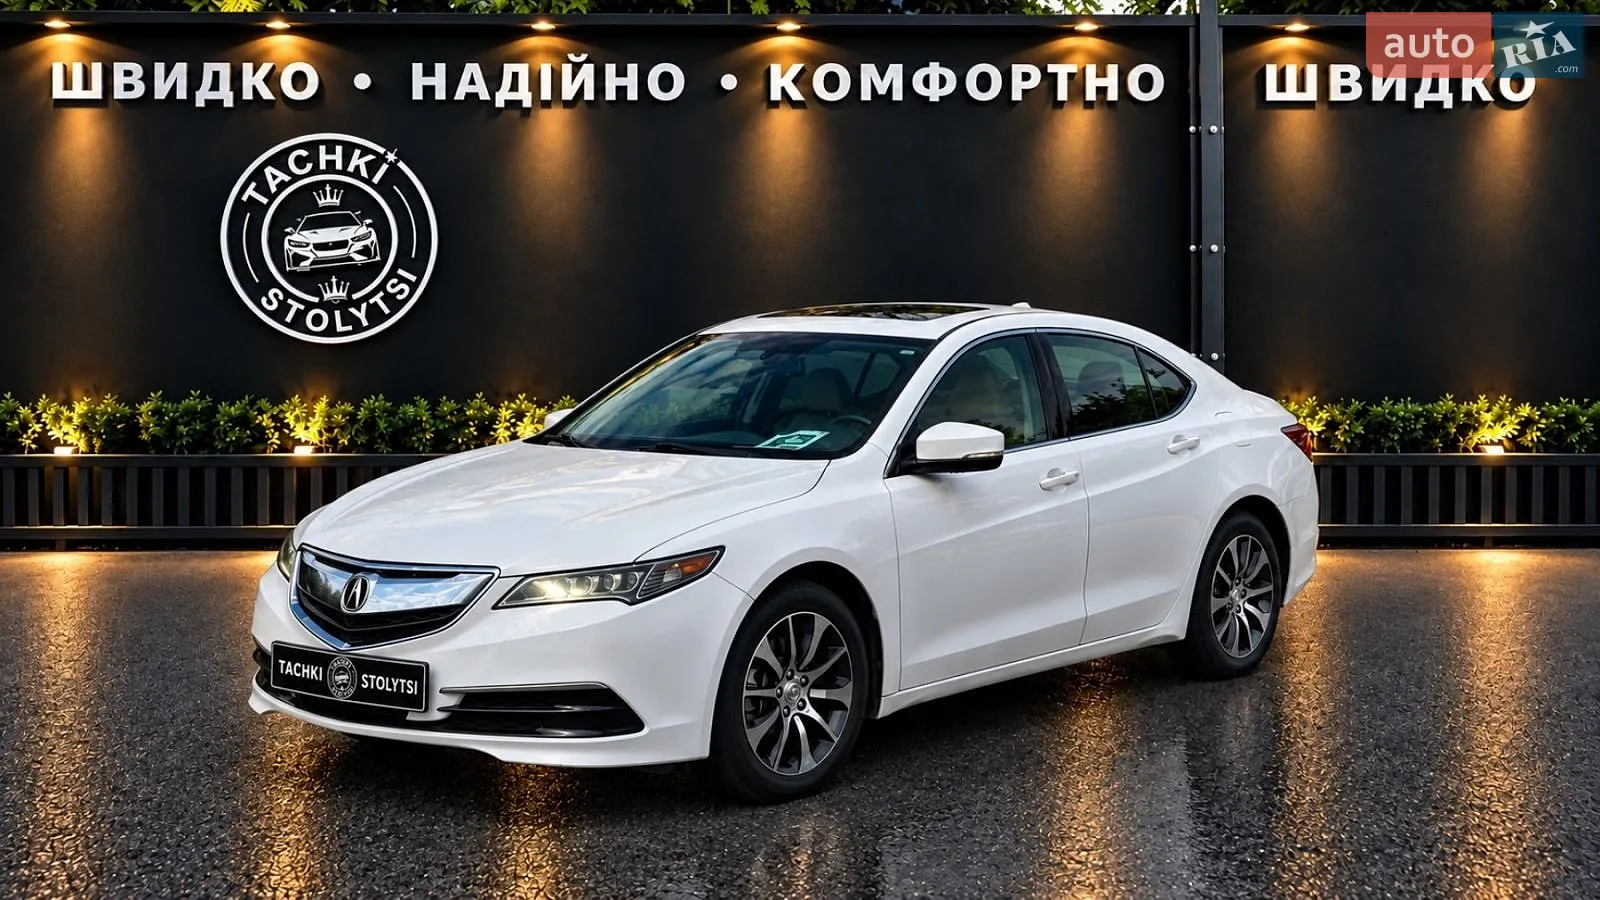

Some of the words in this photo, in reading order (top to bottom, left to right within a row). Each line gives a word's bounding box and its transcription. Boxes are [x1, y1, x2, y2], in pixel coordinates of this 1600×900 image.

[51, 61, 319, 108] ШВИДКО
[411, 52, 686, 108] НАДІЙНО
[769, 61, 1165, 102] КОМФОРТНО
[1265, 63, 1536, 109] ШВИДКО
[241, 144, 390, 205] TACHKI
[260, 267, 418, 333] STOLYTSI
[278, 659, 323, 681] TACHKI
[361, 673, 418, 695] STOLYTSI
